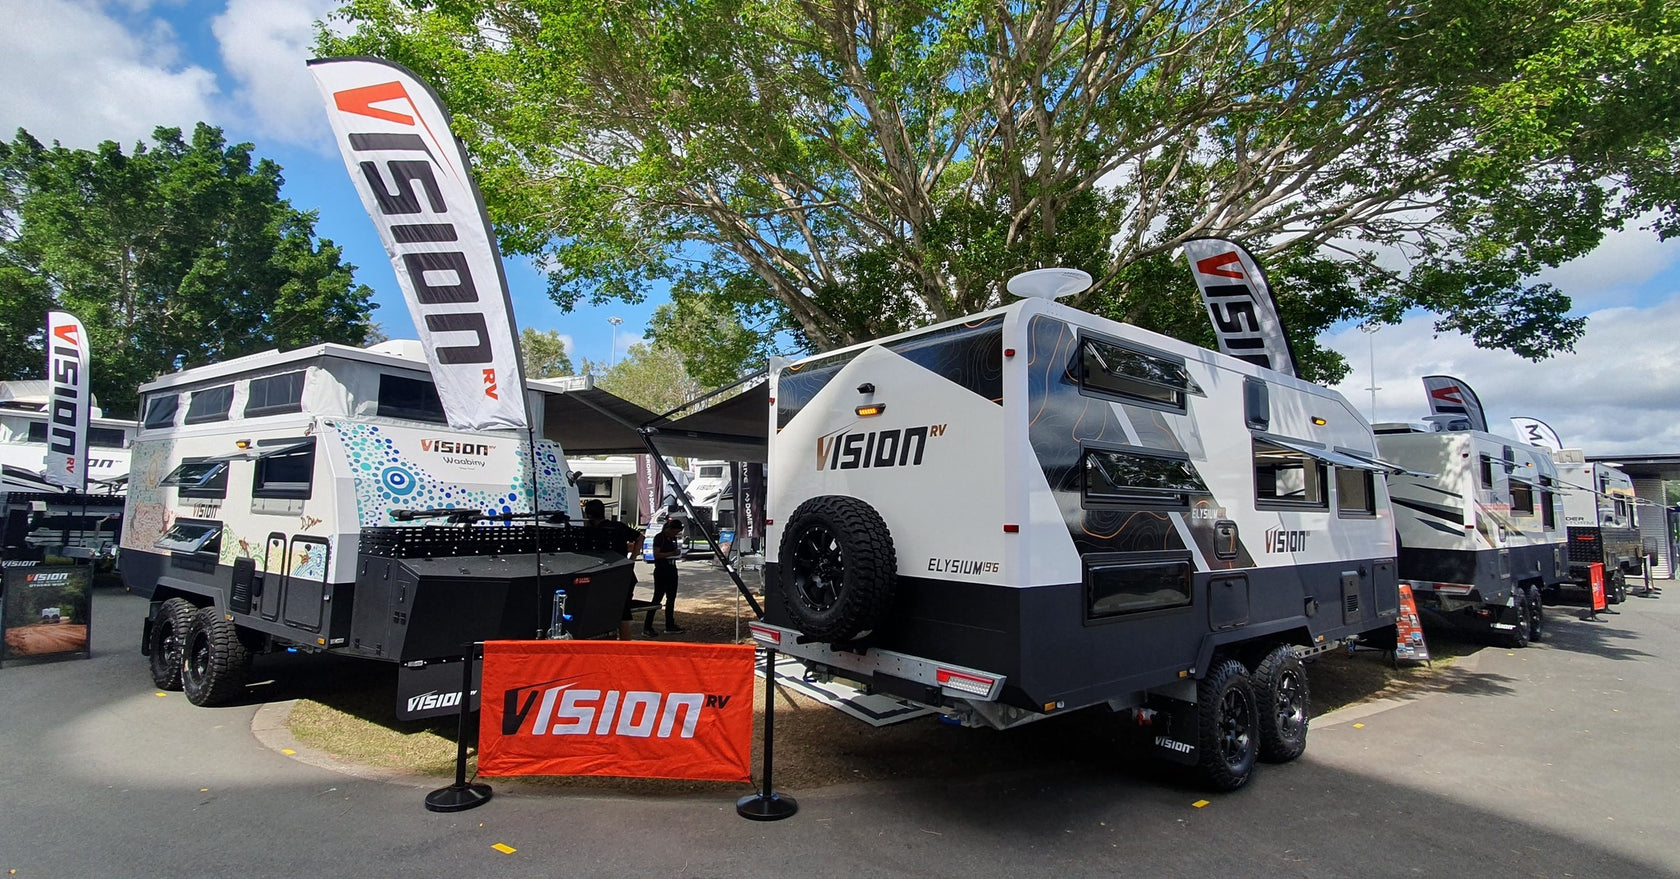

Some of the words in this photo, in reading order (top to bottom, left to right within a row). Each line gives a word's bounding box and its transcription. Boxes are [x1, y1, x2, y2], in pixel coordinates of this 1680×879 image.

[333, 81, 493, 364] VISION
[482, 368, 498, 400] RV
[51, 325, 81, 455] VISION
[421, 439, 488, 456] VISION
[816, 424, 928, 471] VISION
[930, 424, 947, 437] RV
[65, 457, 75, 474] RV
[443, 457, 485, 467] Waabiny
[193, 502, 217, 518] VISION
[1265, 528, 1305, 553] VISION
[2, 560, 37, 568] VISION
[928, 558, 983, 575] ELYSIUM
[26, 573, 68, 582] VISION
[502, 678, 704, 738] VISION
[705, 694, 730, 709] RV
[1155, 736, 1190, 753] VISION
